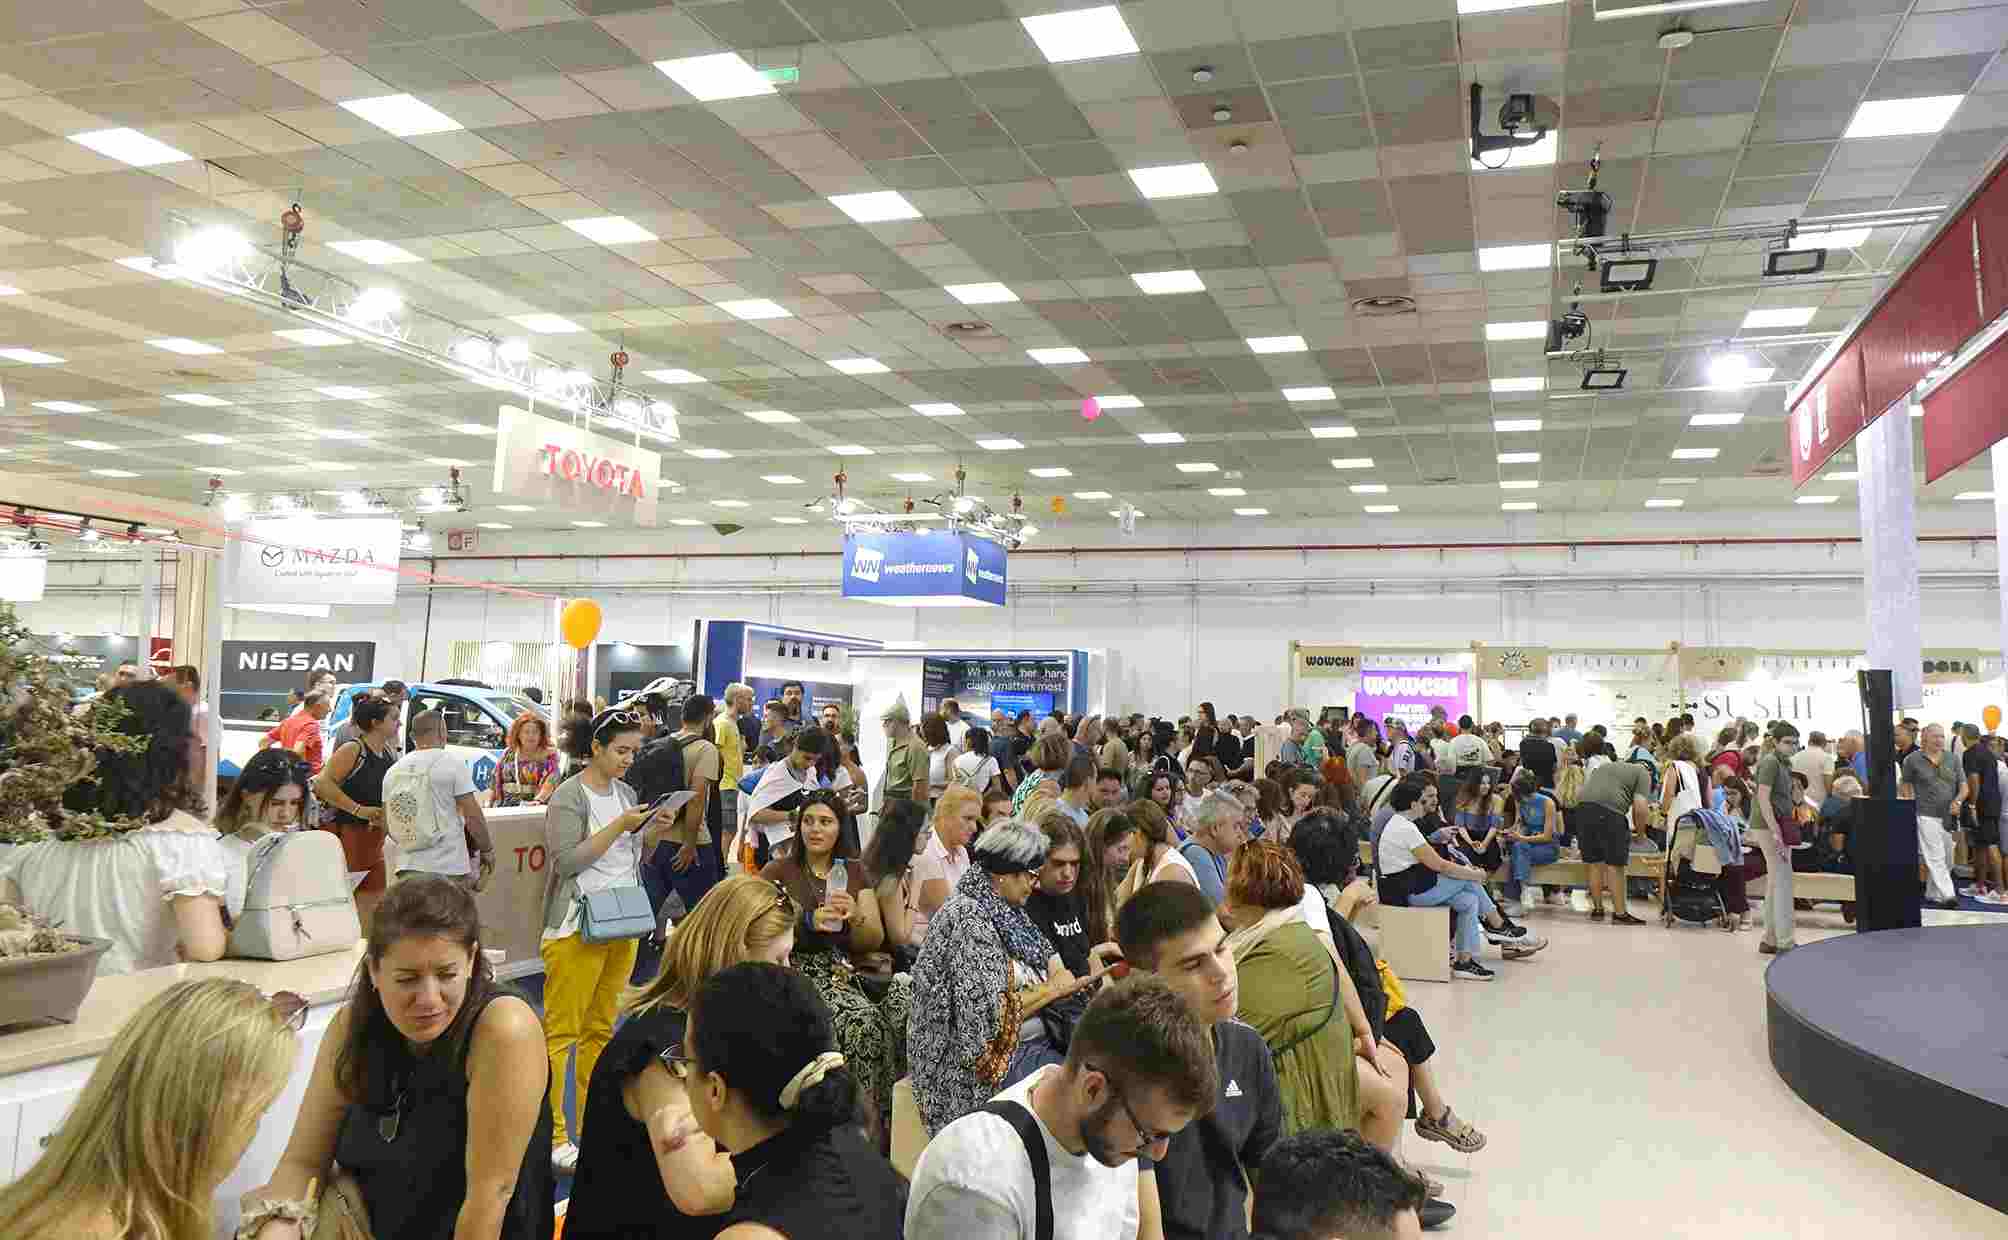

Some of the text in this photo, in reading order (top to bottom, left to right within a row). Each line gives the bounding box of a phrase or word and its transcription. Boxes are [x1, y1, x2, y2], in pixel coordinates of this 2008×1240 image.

[542, 444, 645, 497] TOYOTA
[292, 547, 375, 565] MAZDA
[239, 652, 355, 672] NISSAN
[1305, 656, 1354, 667] WOWCHI
[998, 679, 1035, 692] matters
[1037, 681, 1065, 692] most.
[1703, 695, 1813, 719] SUSHI
